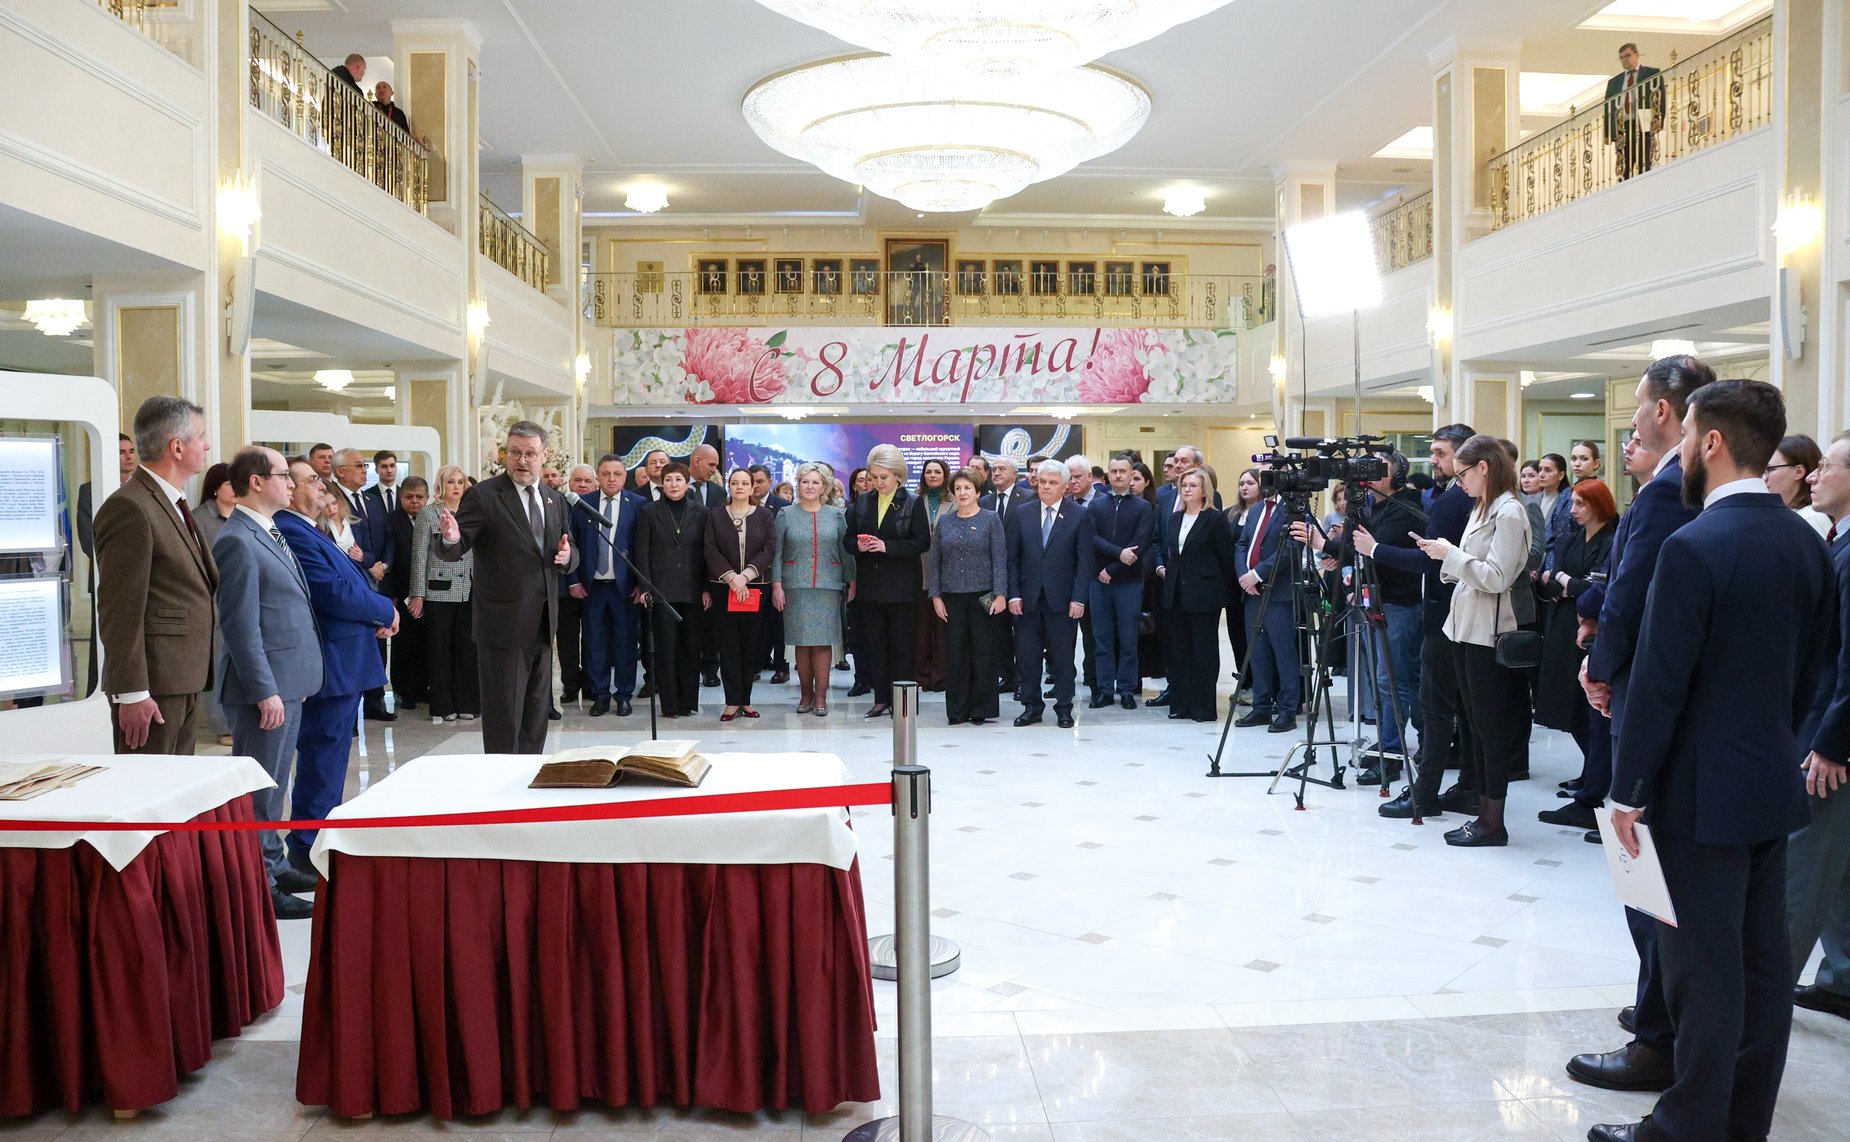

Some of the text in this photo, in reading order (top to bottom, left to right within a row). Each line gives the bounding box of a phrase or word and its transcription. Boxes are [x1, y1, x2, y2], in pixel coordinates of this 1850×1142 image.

[749, 328, 1101, 403] С 8 Марта!
[900, 434, 960, 442] СВЕТЛОГОРСК
